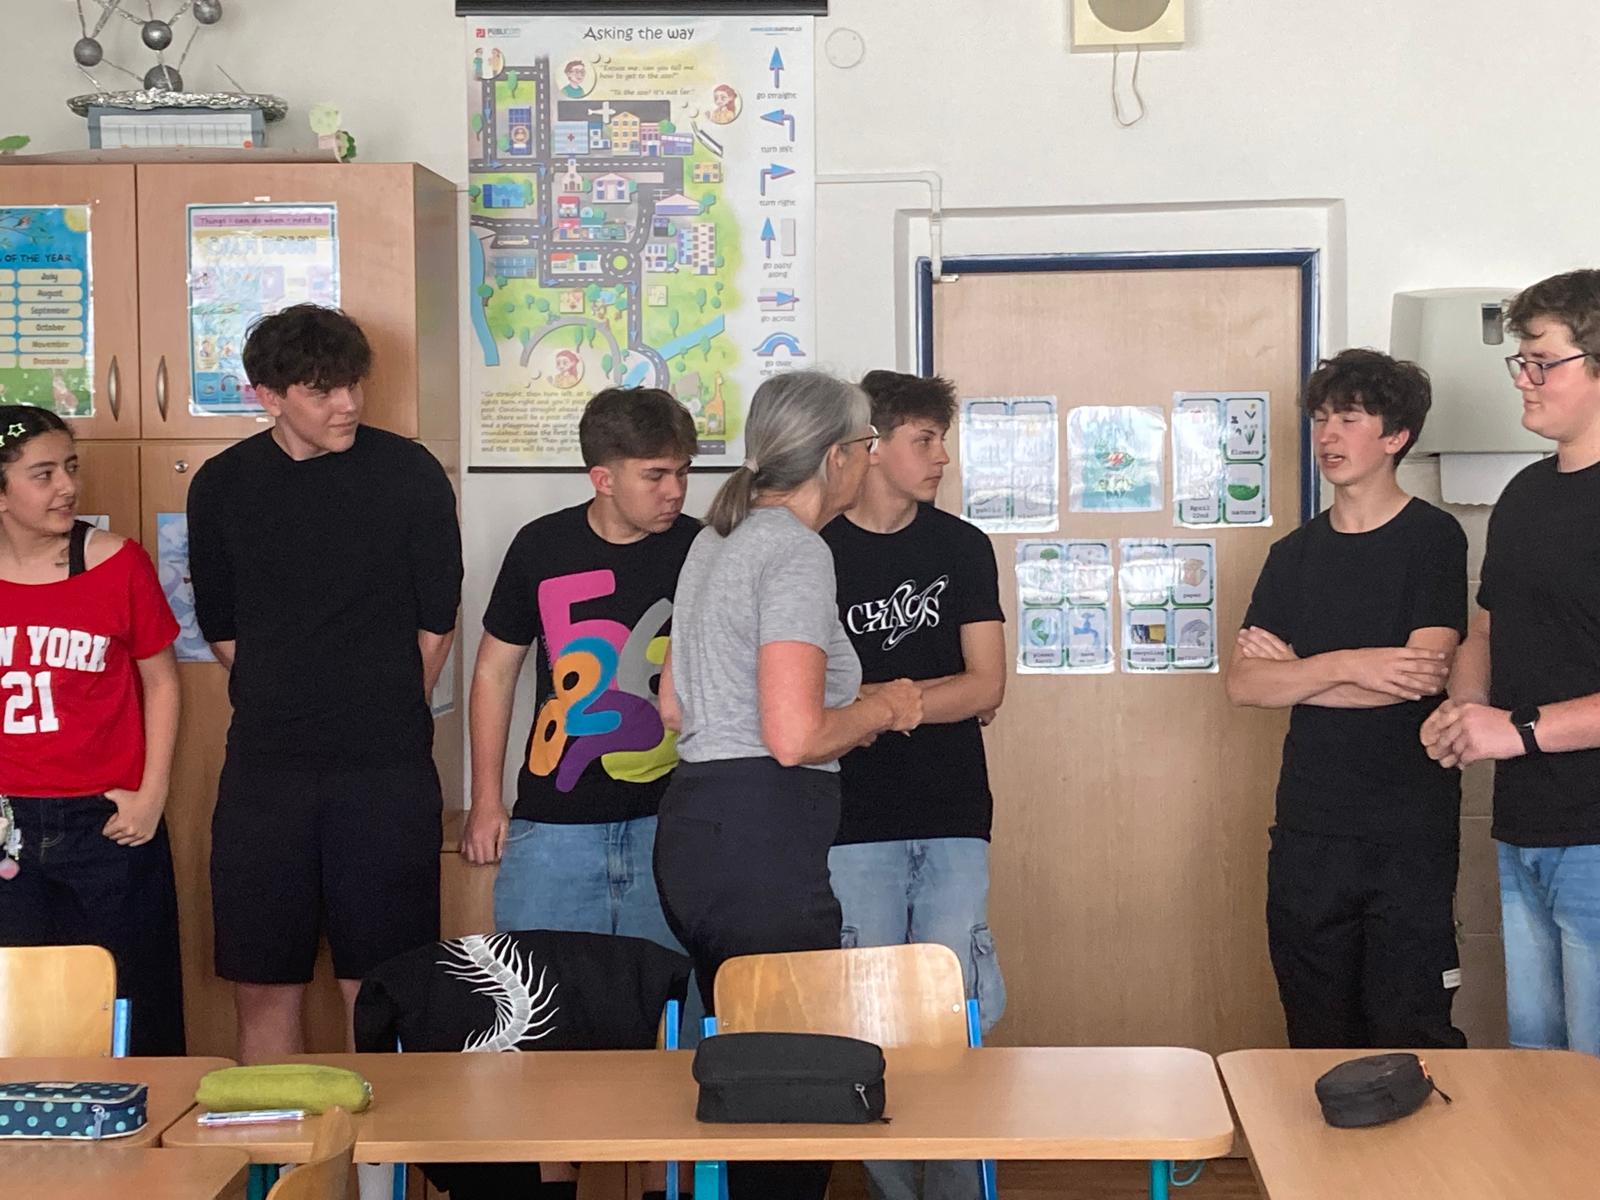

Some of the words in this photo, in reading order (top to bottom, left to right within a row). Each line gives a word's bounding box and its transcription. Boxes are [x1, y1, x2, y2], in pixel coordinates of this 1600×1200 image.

[583, 26, 633, 41] Asking
[638, 27, 663, 39] the
[667, 28, 695, 40] way
[756, 92, 765, 100] go
[760, 199, 776, 207] turn
[777, 199, 796, 207] right
[252, 216, 261, 224] do
[5, 254, 17, 262] OF
[20, 254, 40, 262] THE
[45, 254, 72, 263] YEAR
[763, 262, 772, 270] go
[41, 273, 58, 282] July
[37, 289, 63, 299] August
[31, 307, 70, 317] September
[36, 323, 66, 331] October
[32, 340, 69, 348] November
[0, 671, 59, 734] 21
